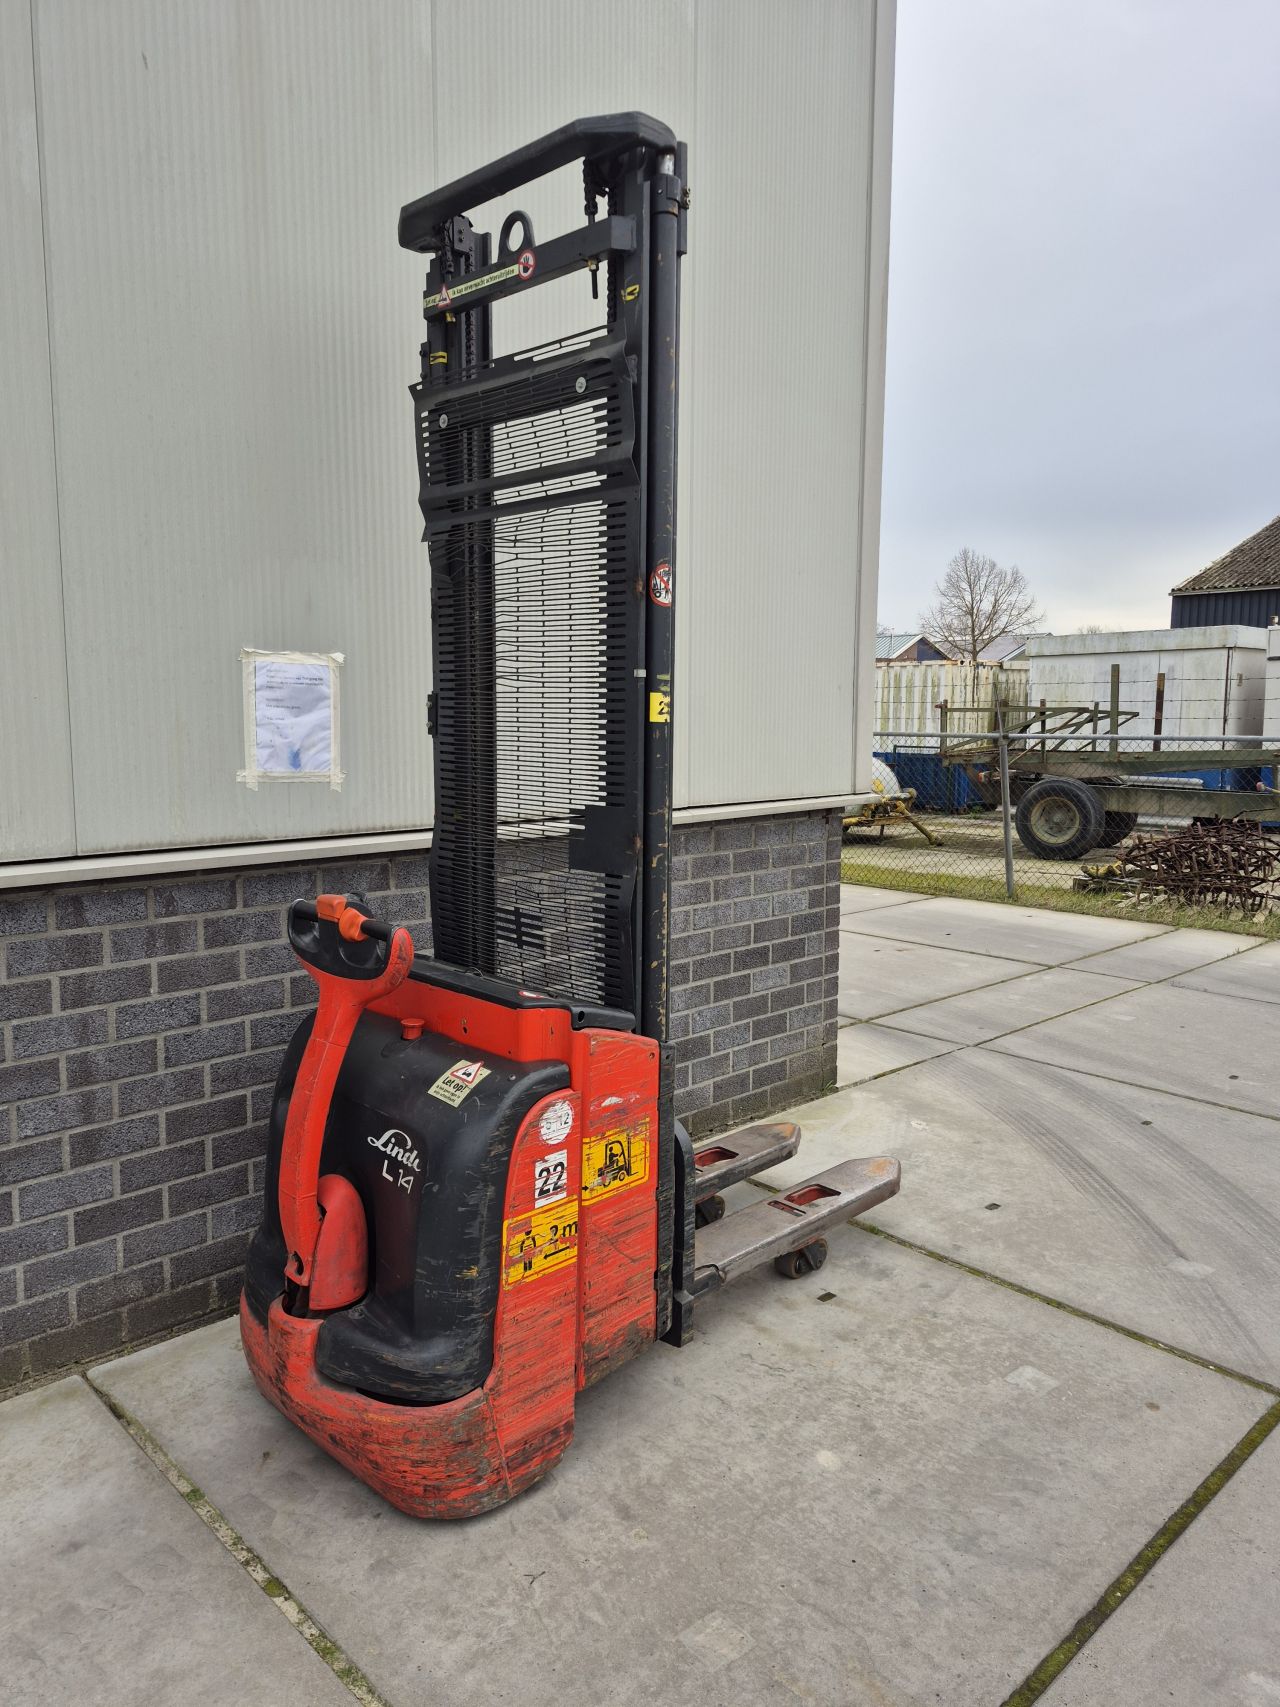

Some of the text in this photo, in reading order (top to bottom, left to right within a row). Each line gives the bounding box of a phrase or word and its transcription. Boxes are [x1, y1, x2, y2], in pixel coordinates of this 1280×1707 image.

[442, 1076, 467, 1093] Let op!
[367, 1128, 421, 1172] Linde
[382, 1159, 414, 1194] L 14
[537, 1161, 565, 1197] 22
